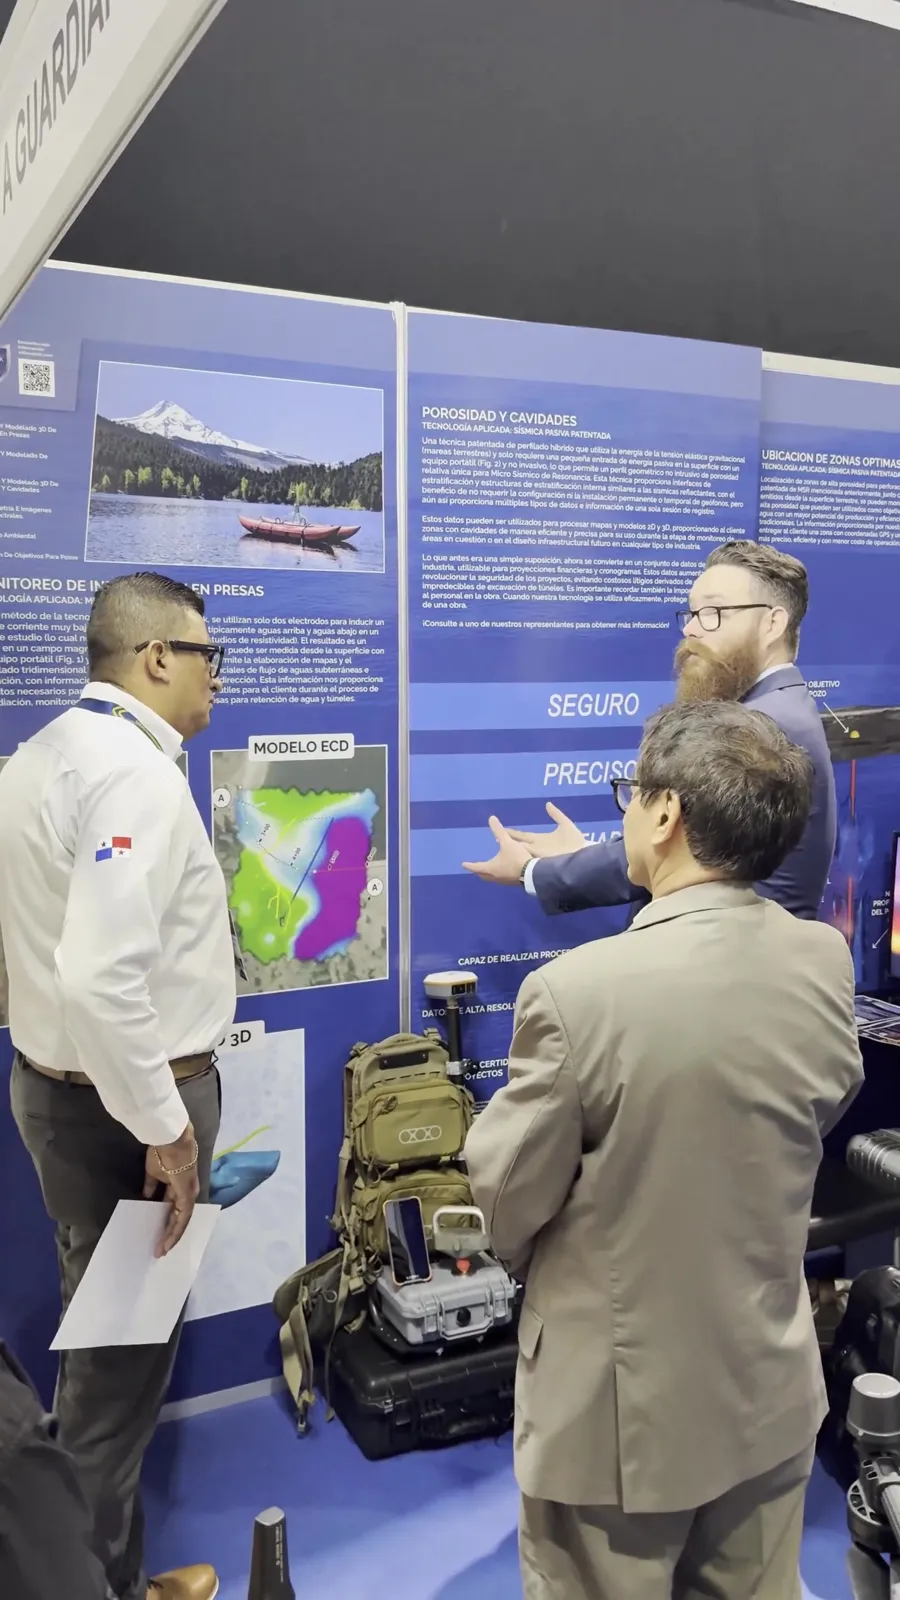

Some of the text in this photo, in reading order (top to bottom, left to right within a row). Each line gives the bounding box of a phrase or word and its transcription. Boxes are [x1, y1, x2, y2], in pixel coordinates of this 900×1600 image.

[16, 0, 110, 184] GUARDIA
[422, 407, 576, 426] POROSIDAD Y CAVIDADES
[423, 422, 610, 440] TECNOLOGÍA APLICADA: SÍSMICA PASIVA PATENTADA
[762, 450, 900, 468] UBICACION DE ZONAS OPTIMAS
[465, 517, 493, 526] pueden
[672, 525, 718, 533] proporcionando
[66, 579, 86, 591] DE
[191, 584, 264, 596] EN PRESAS
[33, 595, 82, 604] APLICADA:
[0, 611, 37, 620] método
[6, 623, 86, 633] corriente muy baj
[336, 627, 357, 636] abajo
[44, 633, 56, 643] (lo
[250, 636, 299, 646] resistividad).
[30, 646, 62, 654] campo
[227, 646, 254, 655] puede
[333, 646, 369, 656] superficie
[20, 654, 53, 664] portátil
[55, 655, 74, 665] (Fig.
[219, 675, 257, 683] dirección.
[277, 675, 323, 683] información
[339, 675, 383, 684] proporciona
[17, 687, 66, 695] necesarios
[338, 686, 368, 694] proceso
[250, 695, 287, 703] retención
[548, 693, 640, 717] SEGURO
[254, 740, 349, 754] MODELO ECD
[458, 949, 569, 966] CAPAZ DE REALIZAR PROCE
[465, 1004, 485, 1014] ALTA
[230, 1030, 251, 1046] 3D
[479, 1059, 508, 1068] CERTID
[465, 1069, 503, 1080] OYECTOS
